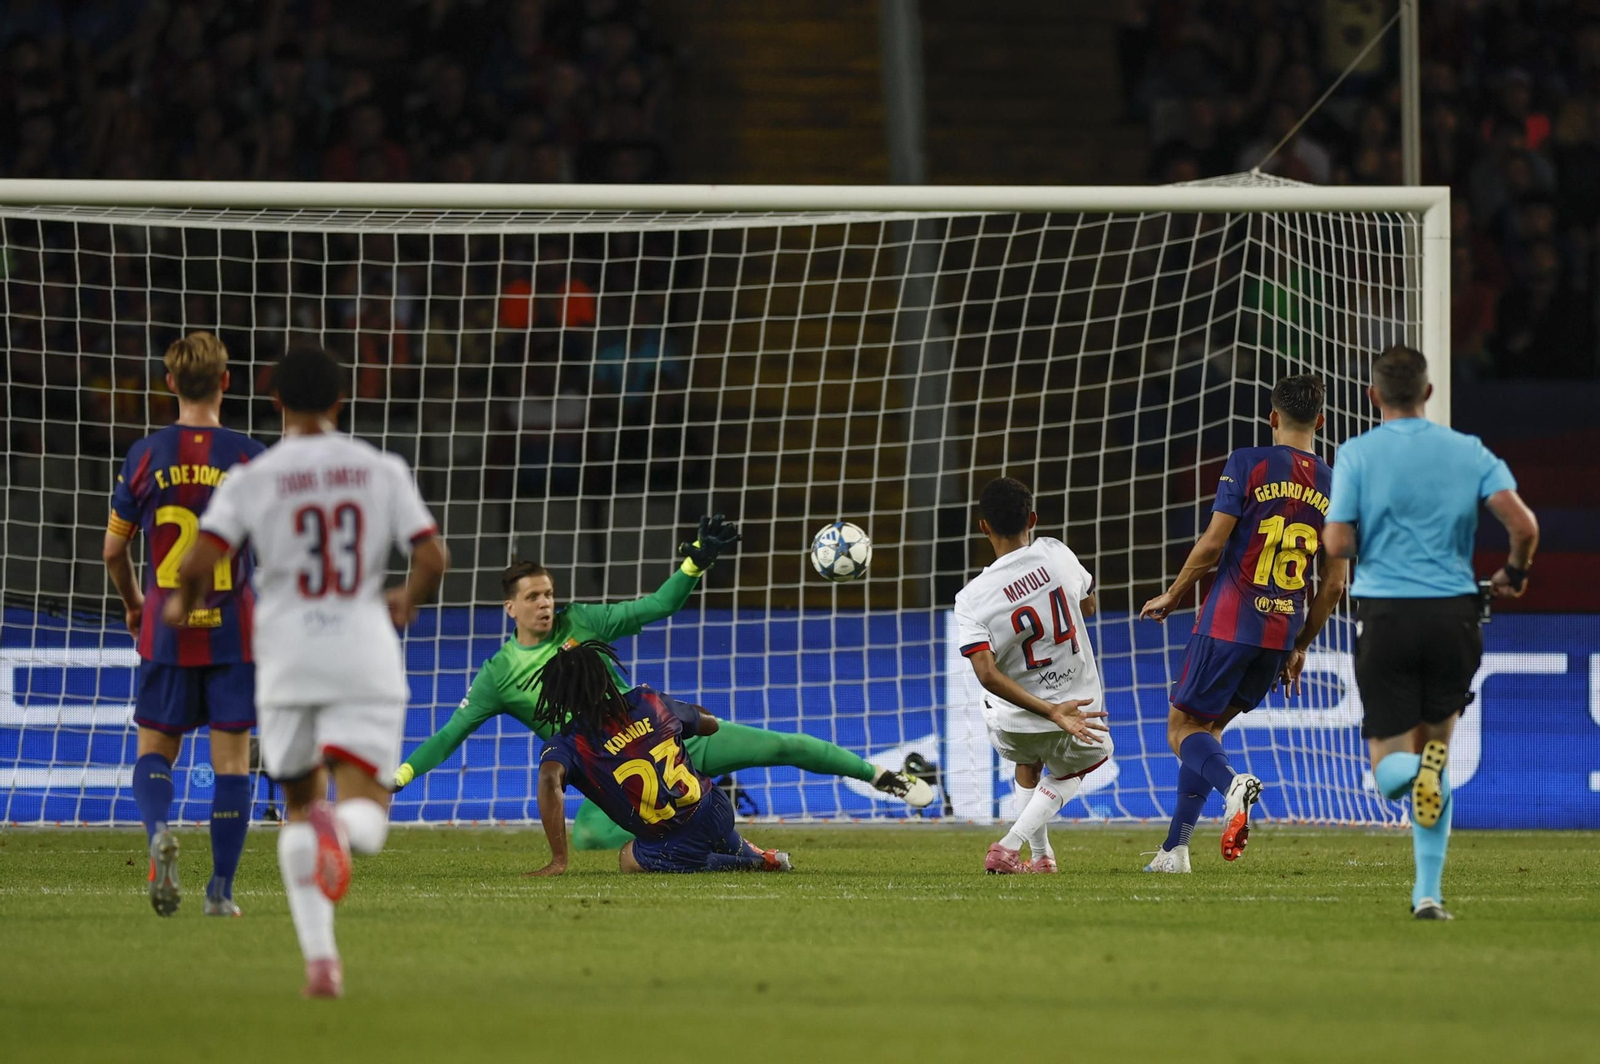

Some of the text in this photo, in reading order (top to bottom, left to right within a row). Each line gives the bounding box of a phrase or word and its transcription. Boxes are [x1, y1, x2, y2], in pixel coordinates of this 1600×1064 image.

[169, 464, 191, 486] DE
[1254, 481, 1331, 517] GERARD MAR
[293, 501, 363, 599] 33
[1253, 514, 1318, 591] 18
[1002, 566, 1051, 603] MAYULU
[1010, 585, 1080, 671] 24
[603, 717, 655, 756] KOUNDE
[612, 736, 702, 825] 23
